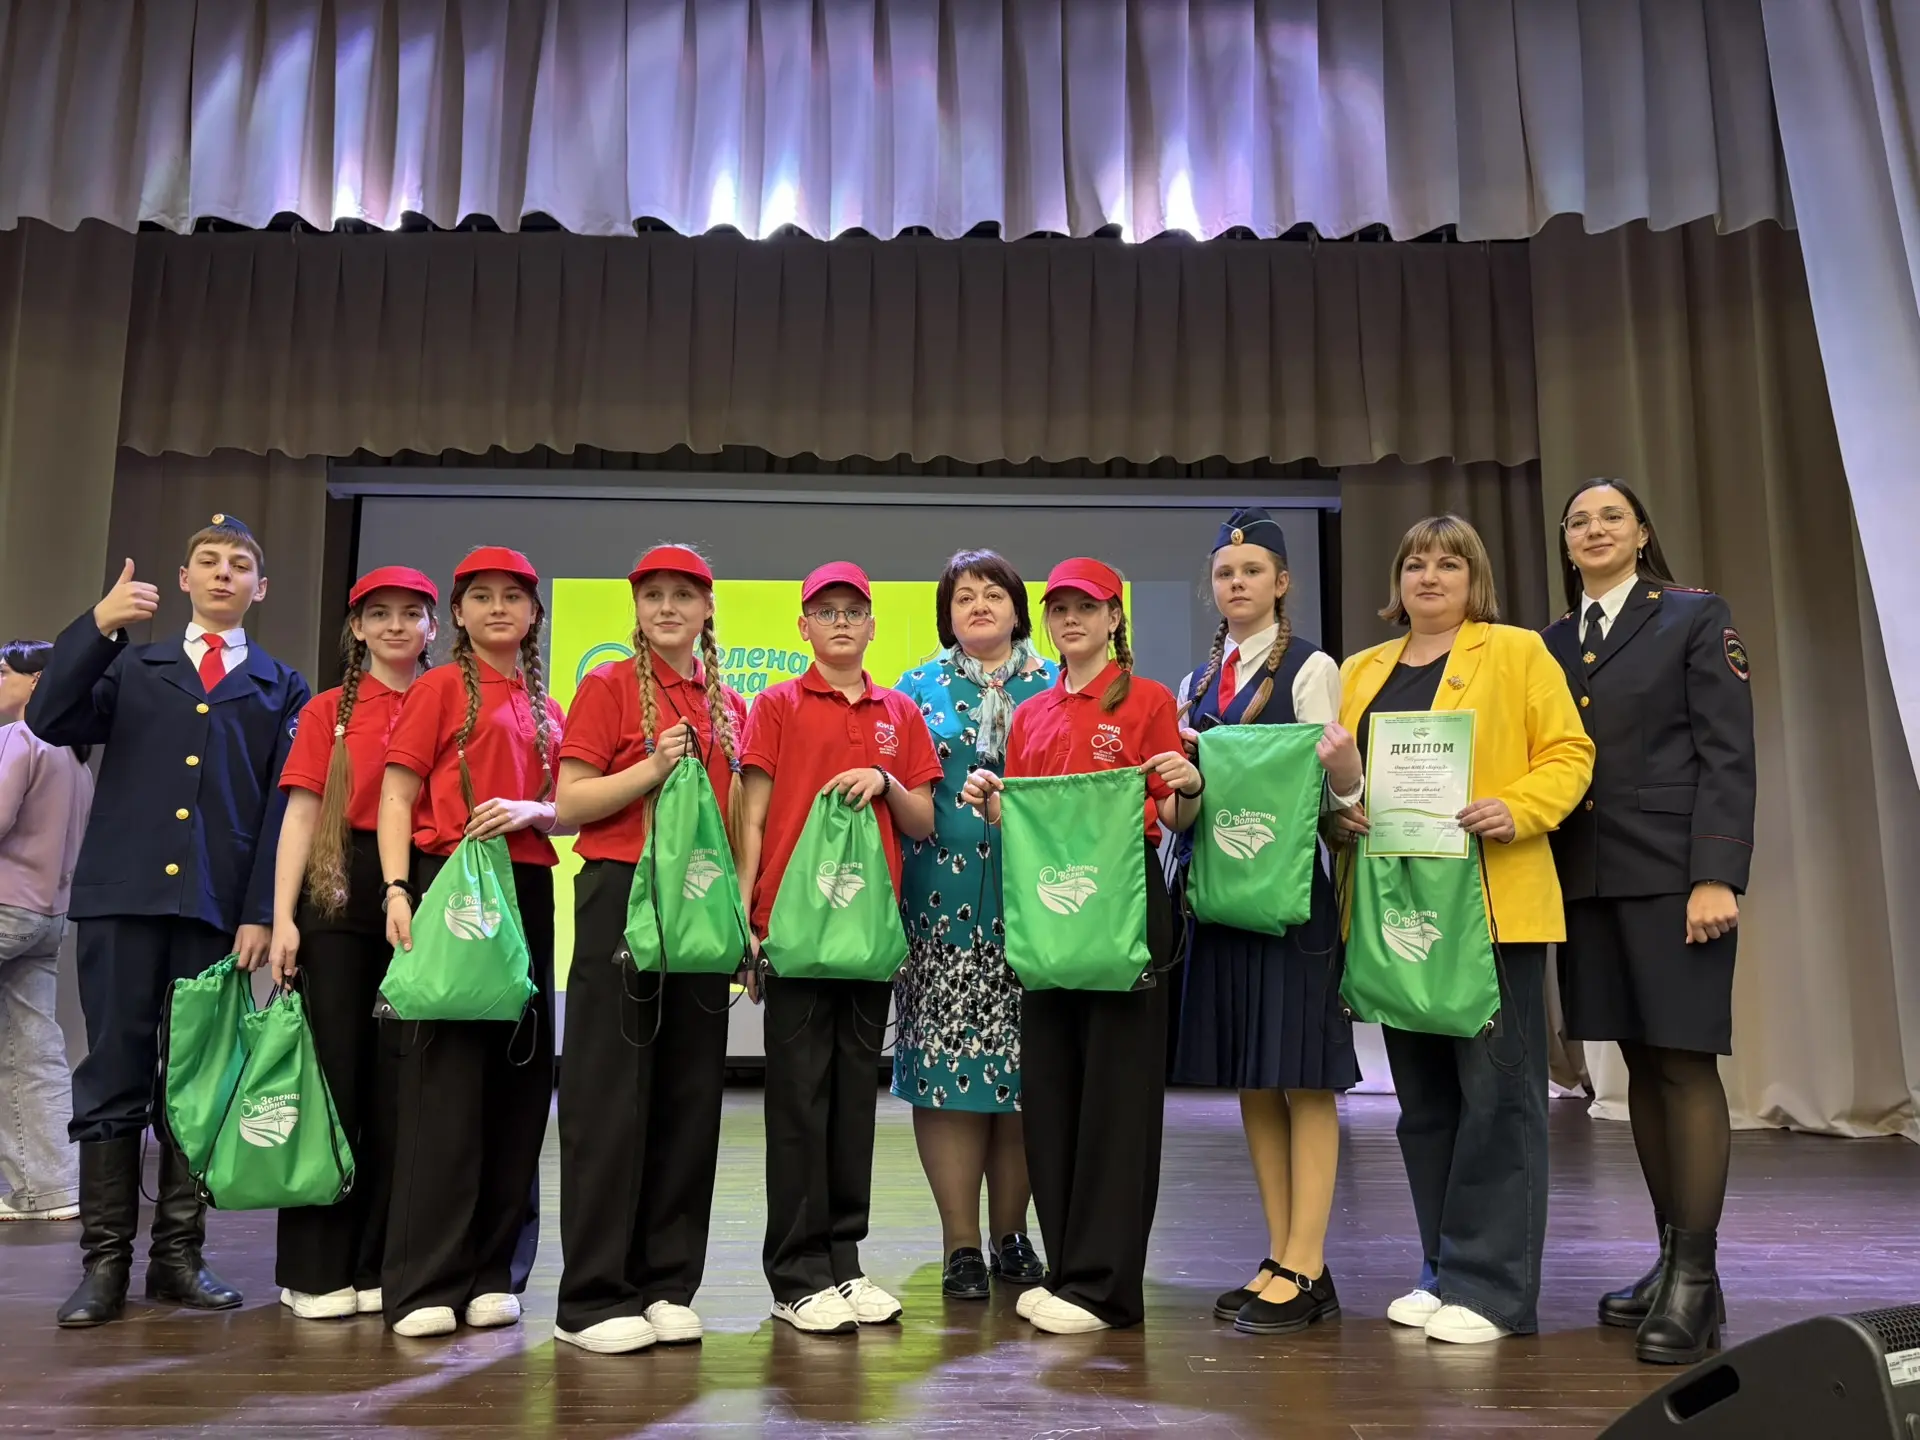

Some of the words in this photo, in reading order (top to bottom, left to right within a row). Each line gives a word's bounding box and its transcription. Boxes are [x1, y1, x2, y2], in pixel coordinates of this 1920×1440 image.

[1097, 723, 1121, 735] ЮИД
[1390, 743, 1454, 755] ДИПЛОМ
[1232, 815, 1261, 825] Волна
[1240, 808, 1277, 823] Зеленая
[254, 1100, 287, 1114] Волна
